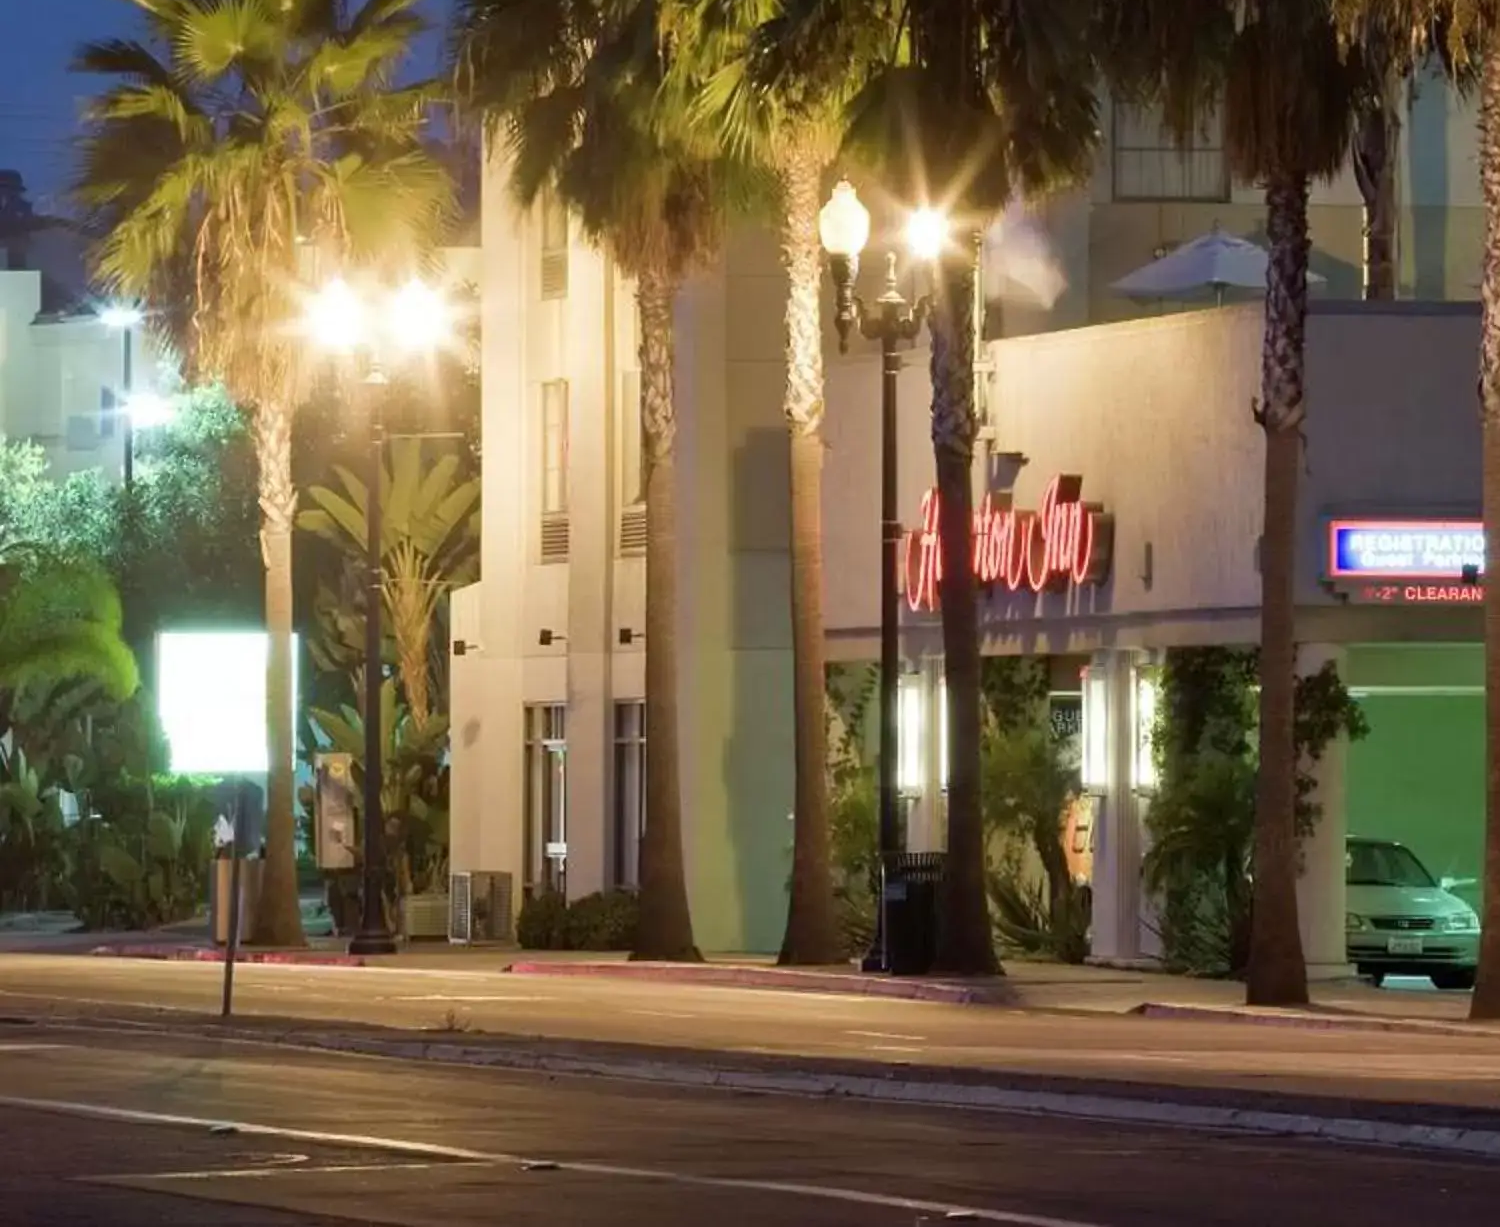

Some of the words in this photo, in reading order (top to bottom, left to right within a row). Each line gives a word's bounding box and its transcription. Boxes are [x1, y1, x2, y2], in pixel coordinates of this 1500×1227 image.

[1028, 473, 1092, 591] Inn
[1350, 534, 1485, 552] REGISTRATIO
[1405, 586, 1483, 601] CLEARAN
